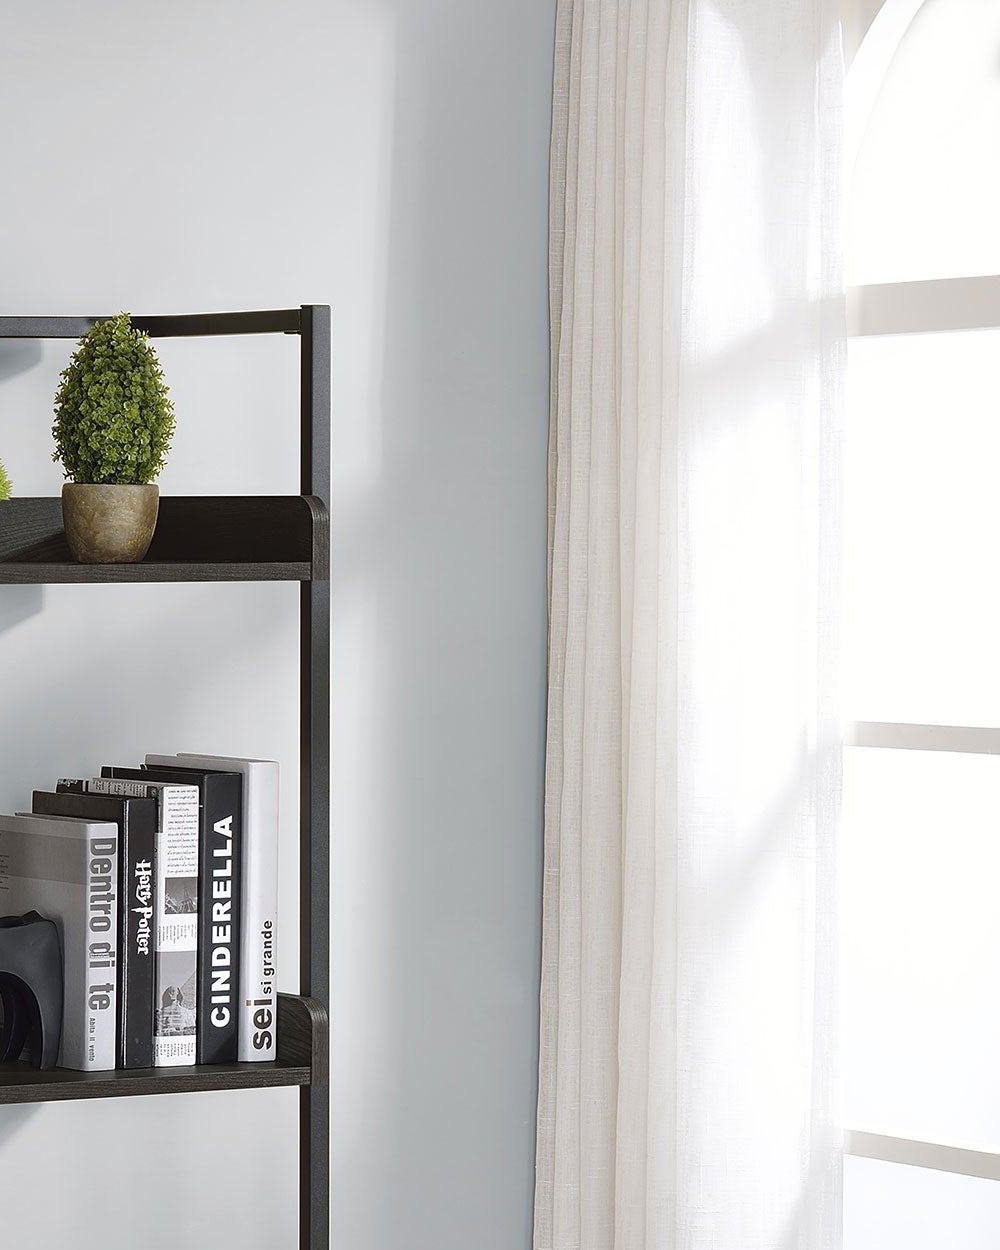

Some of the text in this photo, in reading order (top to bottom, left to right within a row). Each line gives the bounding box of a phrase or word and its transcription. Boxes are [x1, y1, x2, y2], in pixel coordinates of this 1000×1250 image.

[88, 837, 117, 1011] Dentro di te
[131, 905, 153, 956] Potter
[211, 816, 233, 1028] CINDERELLA
[246, 919, 276, 1050] sei si grande
